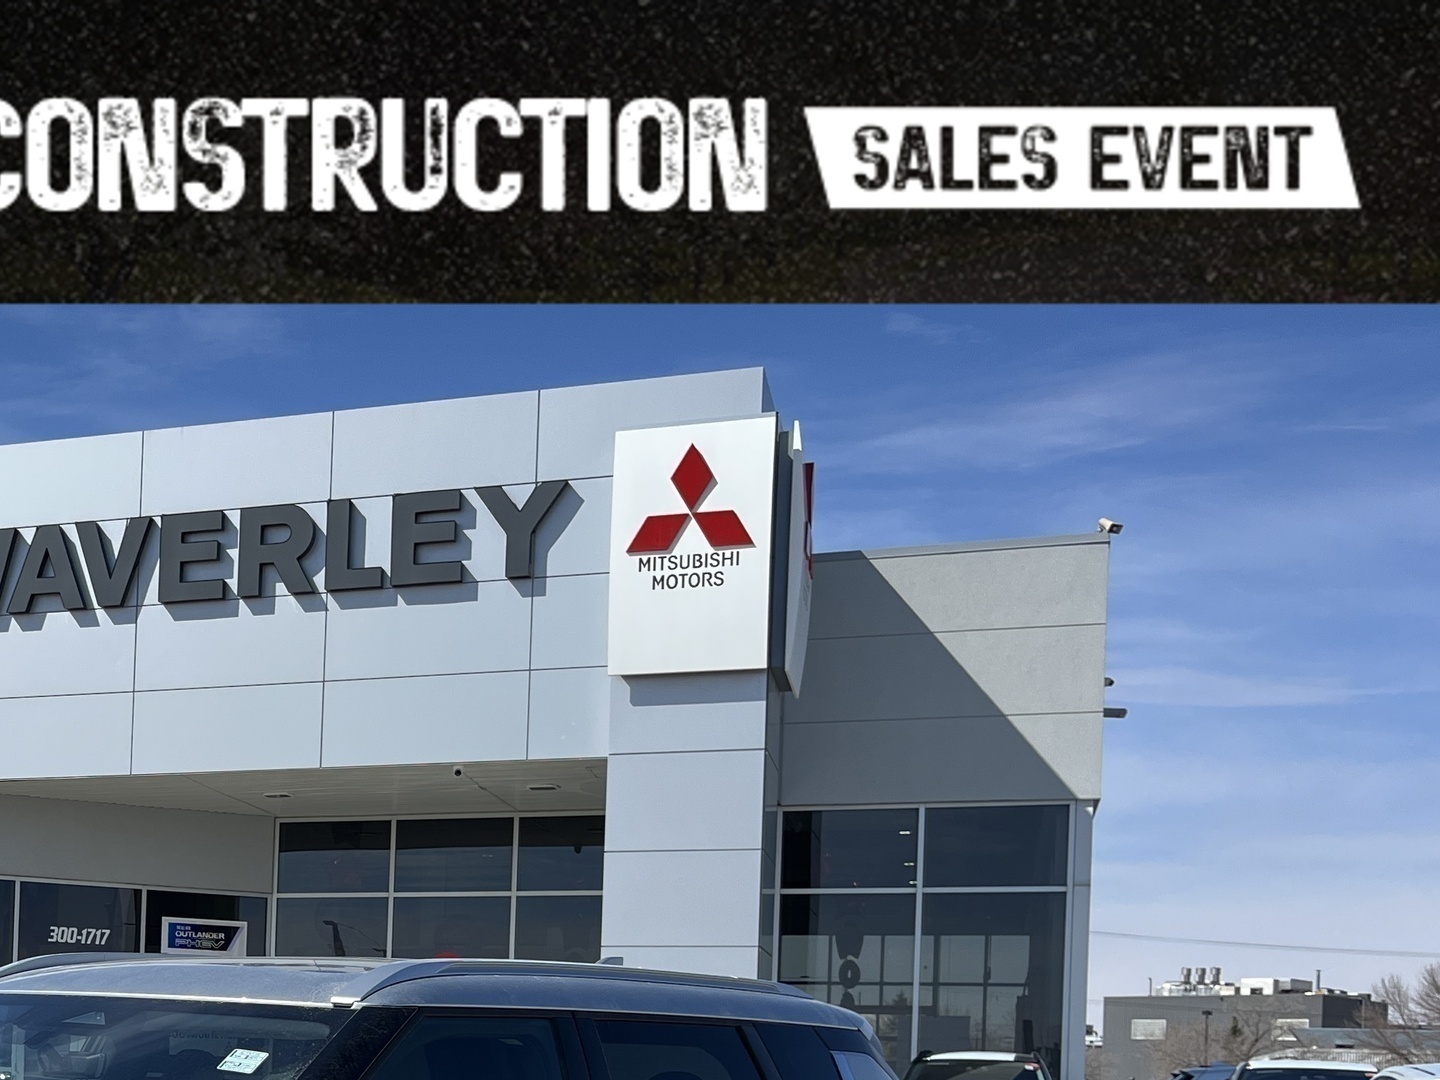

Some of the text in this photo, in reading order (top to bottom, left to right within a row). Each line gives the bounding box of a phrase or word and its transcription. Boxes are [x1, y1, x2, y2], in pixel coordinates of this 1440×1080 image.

[638, 551, 740, 573] MITSUBISHI
[651, 571, 725, 590] MOTORS
[48, 926, 110, 945] 300-1717
[175, 931, 225, 939] OUTLANDER
